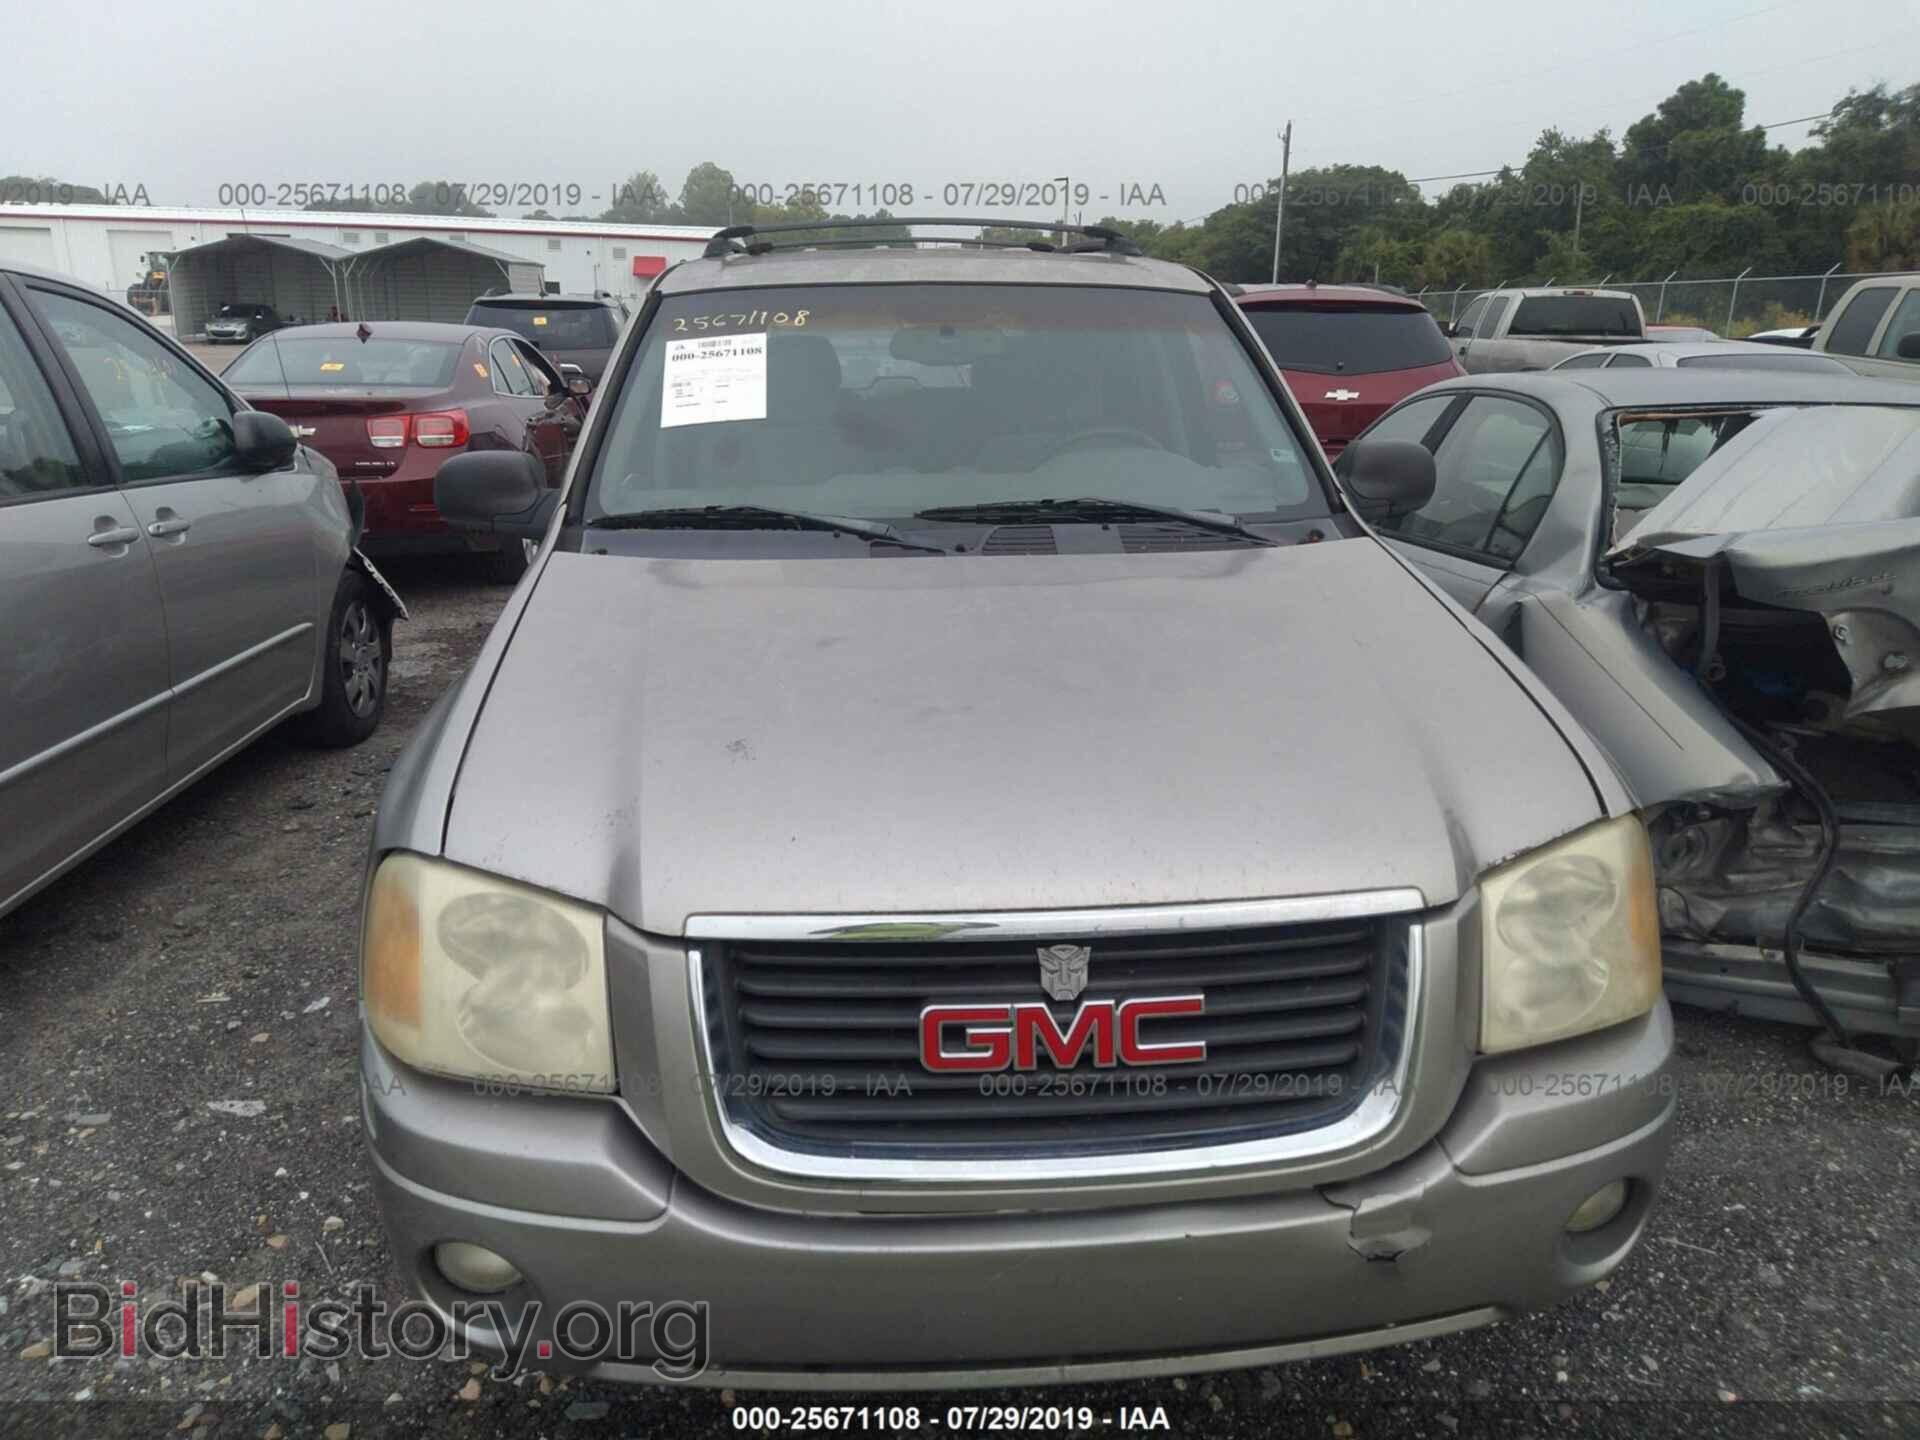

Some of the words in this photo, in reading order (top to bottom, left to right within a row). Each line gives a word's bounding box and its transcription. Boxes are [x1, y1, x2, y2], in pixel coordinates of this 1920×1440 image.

[673, 310, 811, 332] 25671108
[671, 346, 763, 362] 000-25671108
[920, 994, 1208, 1073] GMC
